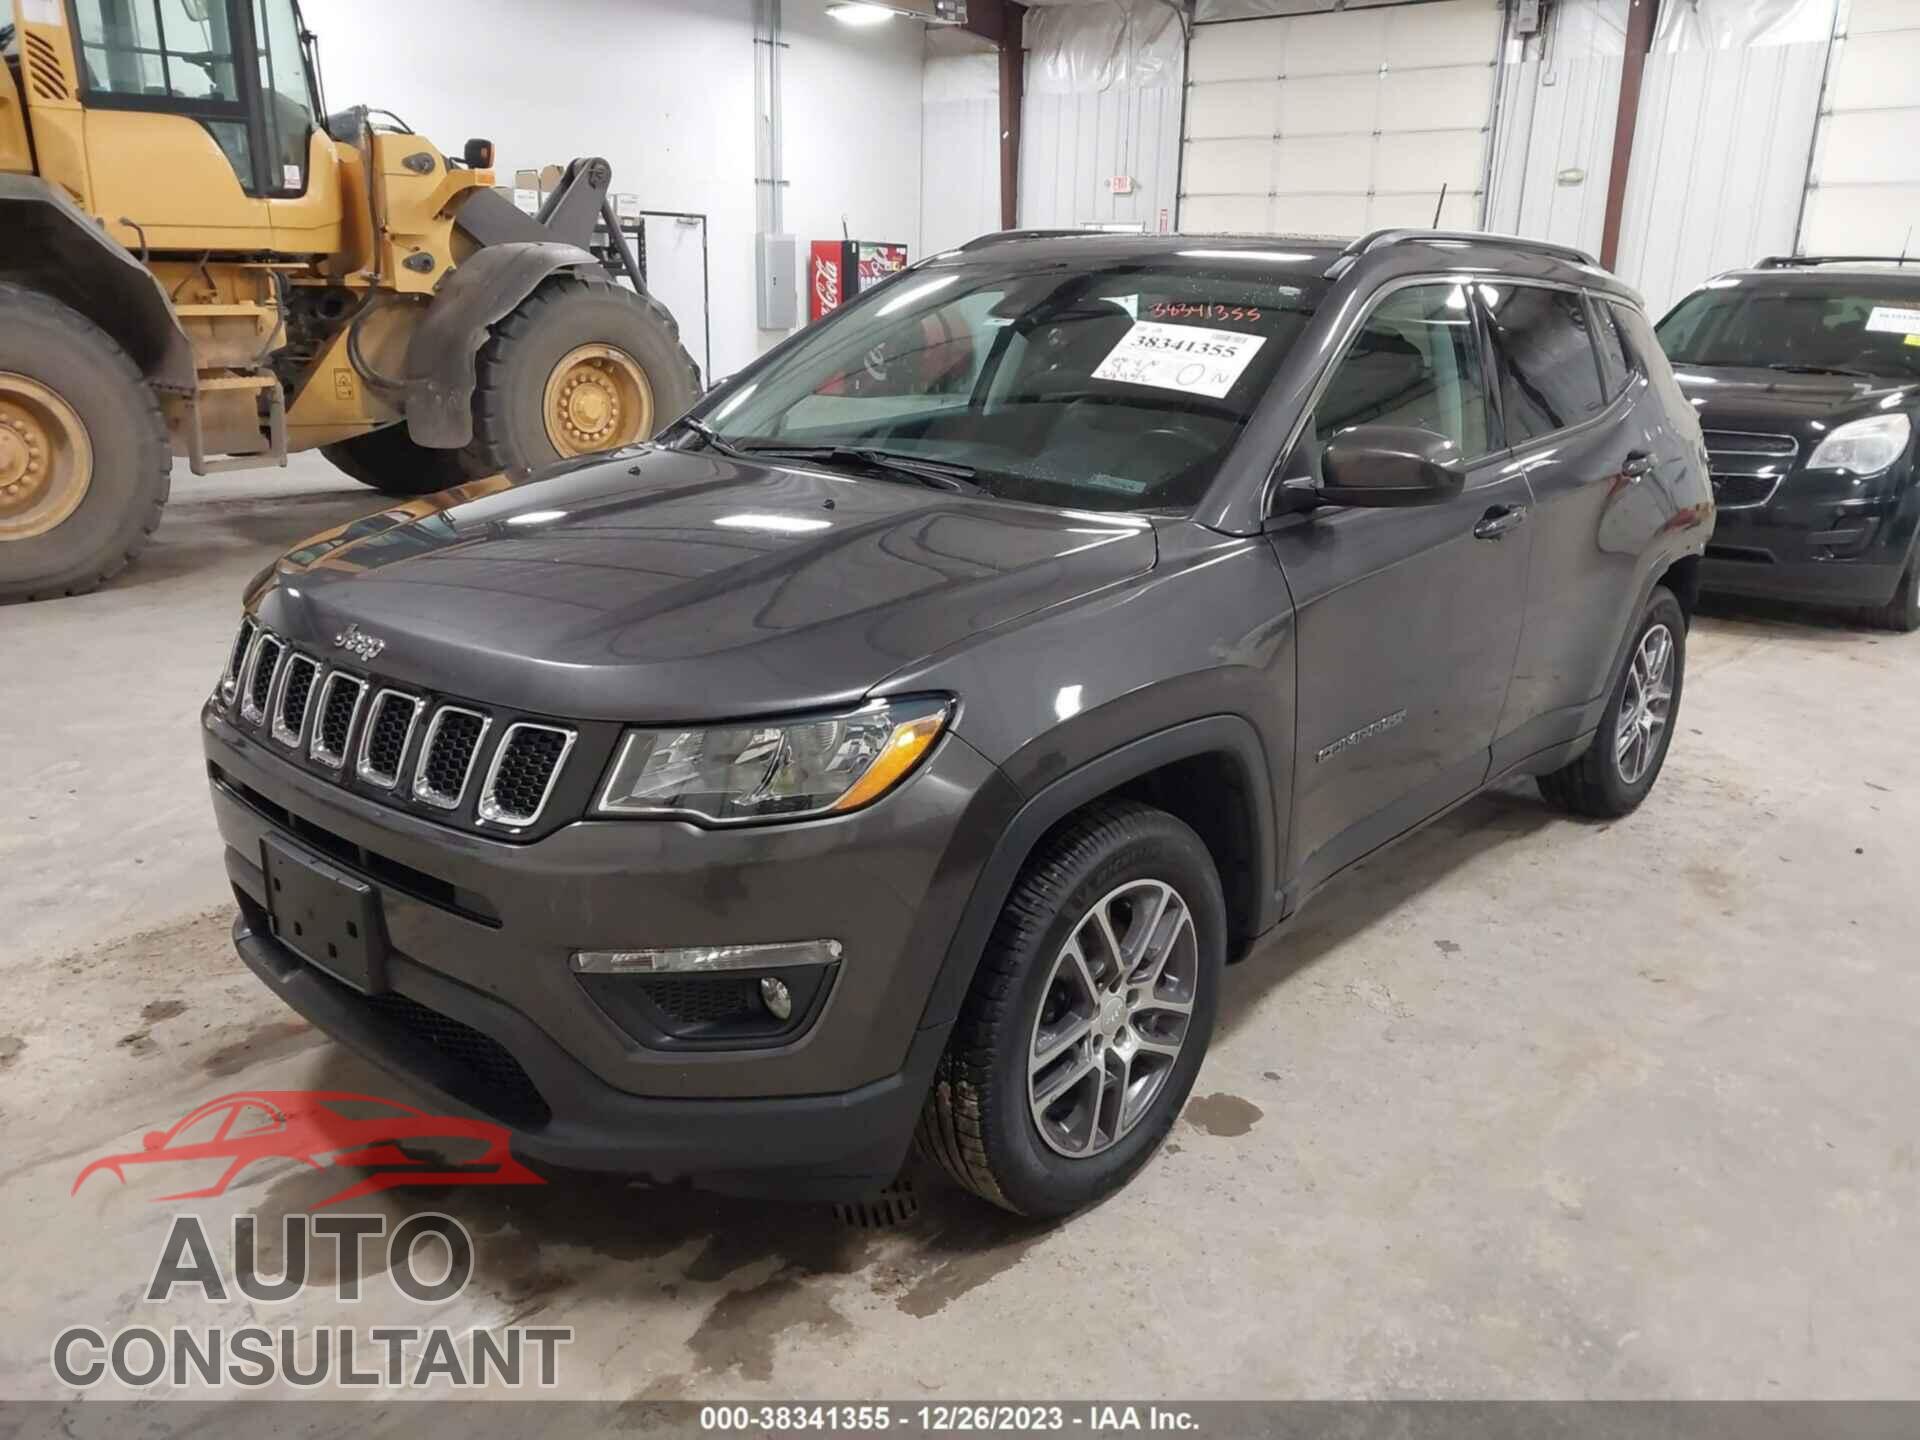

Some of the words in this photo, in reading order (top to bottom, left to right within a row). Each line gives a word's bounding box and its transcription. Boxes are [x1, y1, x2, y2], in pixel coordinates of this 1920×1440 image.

[1153, 303, 1261, 322] 38341355
[1131, 335, 1239, 358] 38341355
[333, 624, 386, 662] Jeep
